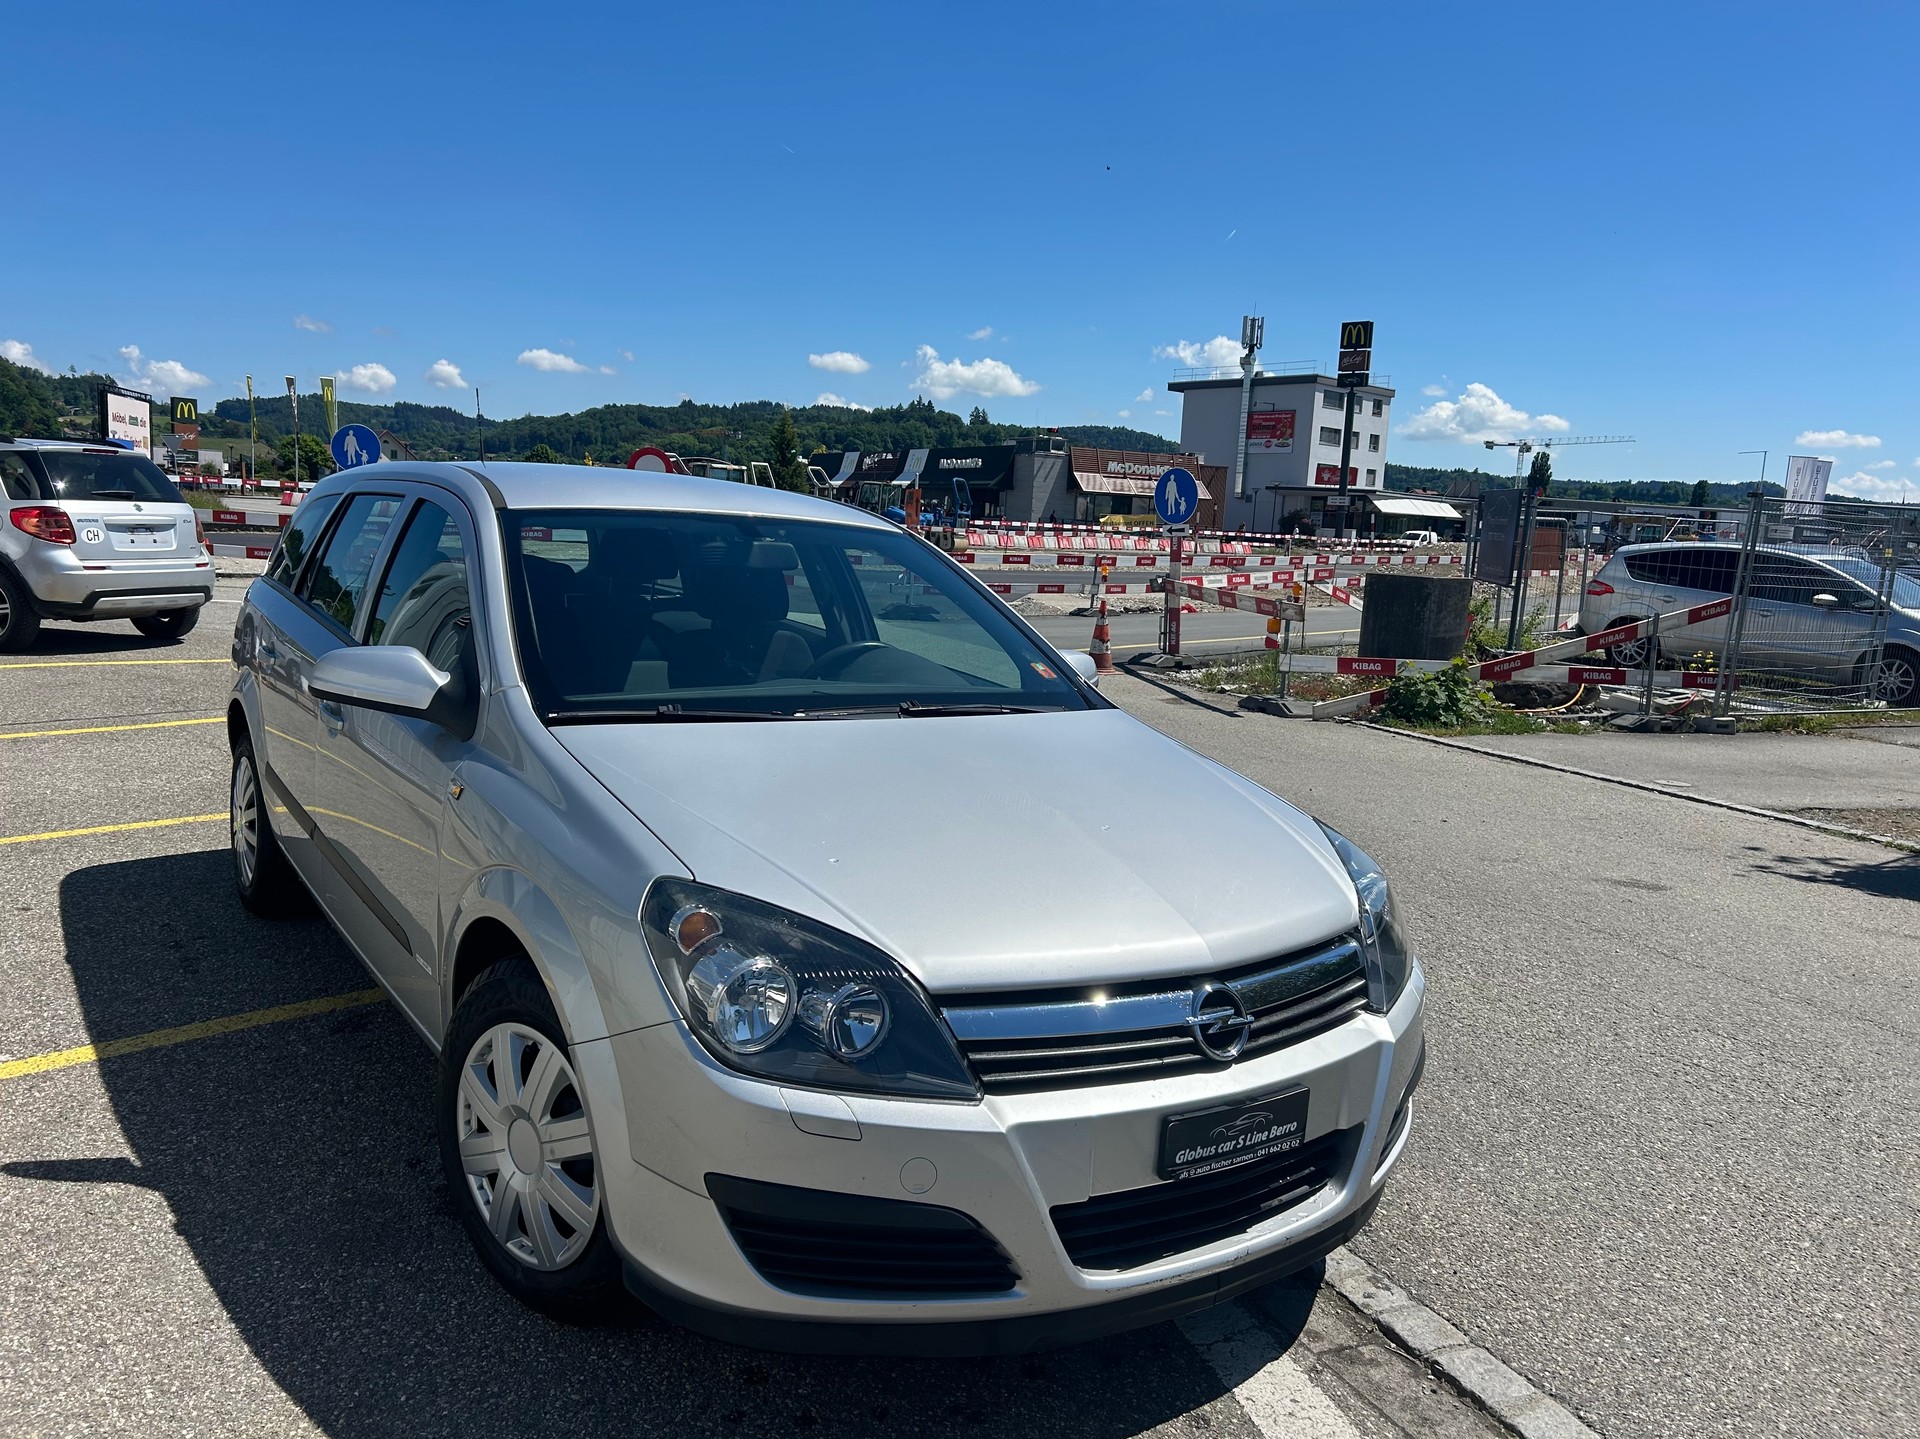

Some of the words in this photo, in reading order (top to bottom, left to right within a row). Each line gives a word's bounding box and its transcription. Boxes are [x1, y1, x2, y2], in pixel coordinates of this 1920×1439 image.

[938, 457, 982, 469] McDonald's
[1107, 461, 1171, 476] McDonald
[86, 529, 100, 542] CH
[1232, 576, 1246, 584] KIBAG
[1701, 604, 1727, 617] KIBAG
[1599, 632, 1625, 645] KIBAG
[1352, 662, 1382, 671] KIBAG
[1494, 660, 1521, 673] KIBAG
[1582, 671, 1612, 681] KIBAG
[1175, 1143, 1216, 1164] Globus
[1217, 1141, 1236, 1154] car
[1236, 1138, 1244, 1148] S
[1245, 1131, 1268, 1146] Line
[1269, 1121, 1298, 1138] Berro
[1195, 1165, 1211, 1174] auto
[1211, 1158, 1232, 1170] fischer
[1257, 1148, 1269, 1157] 041
[1269, 1145, 1281, 1154] 662
[1281, 1142, 1291, 1150] 02
[1290, 1139, 1300, 1148] 02
